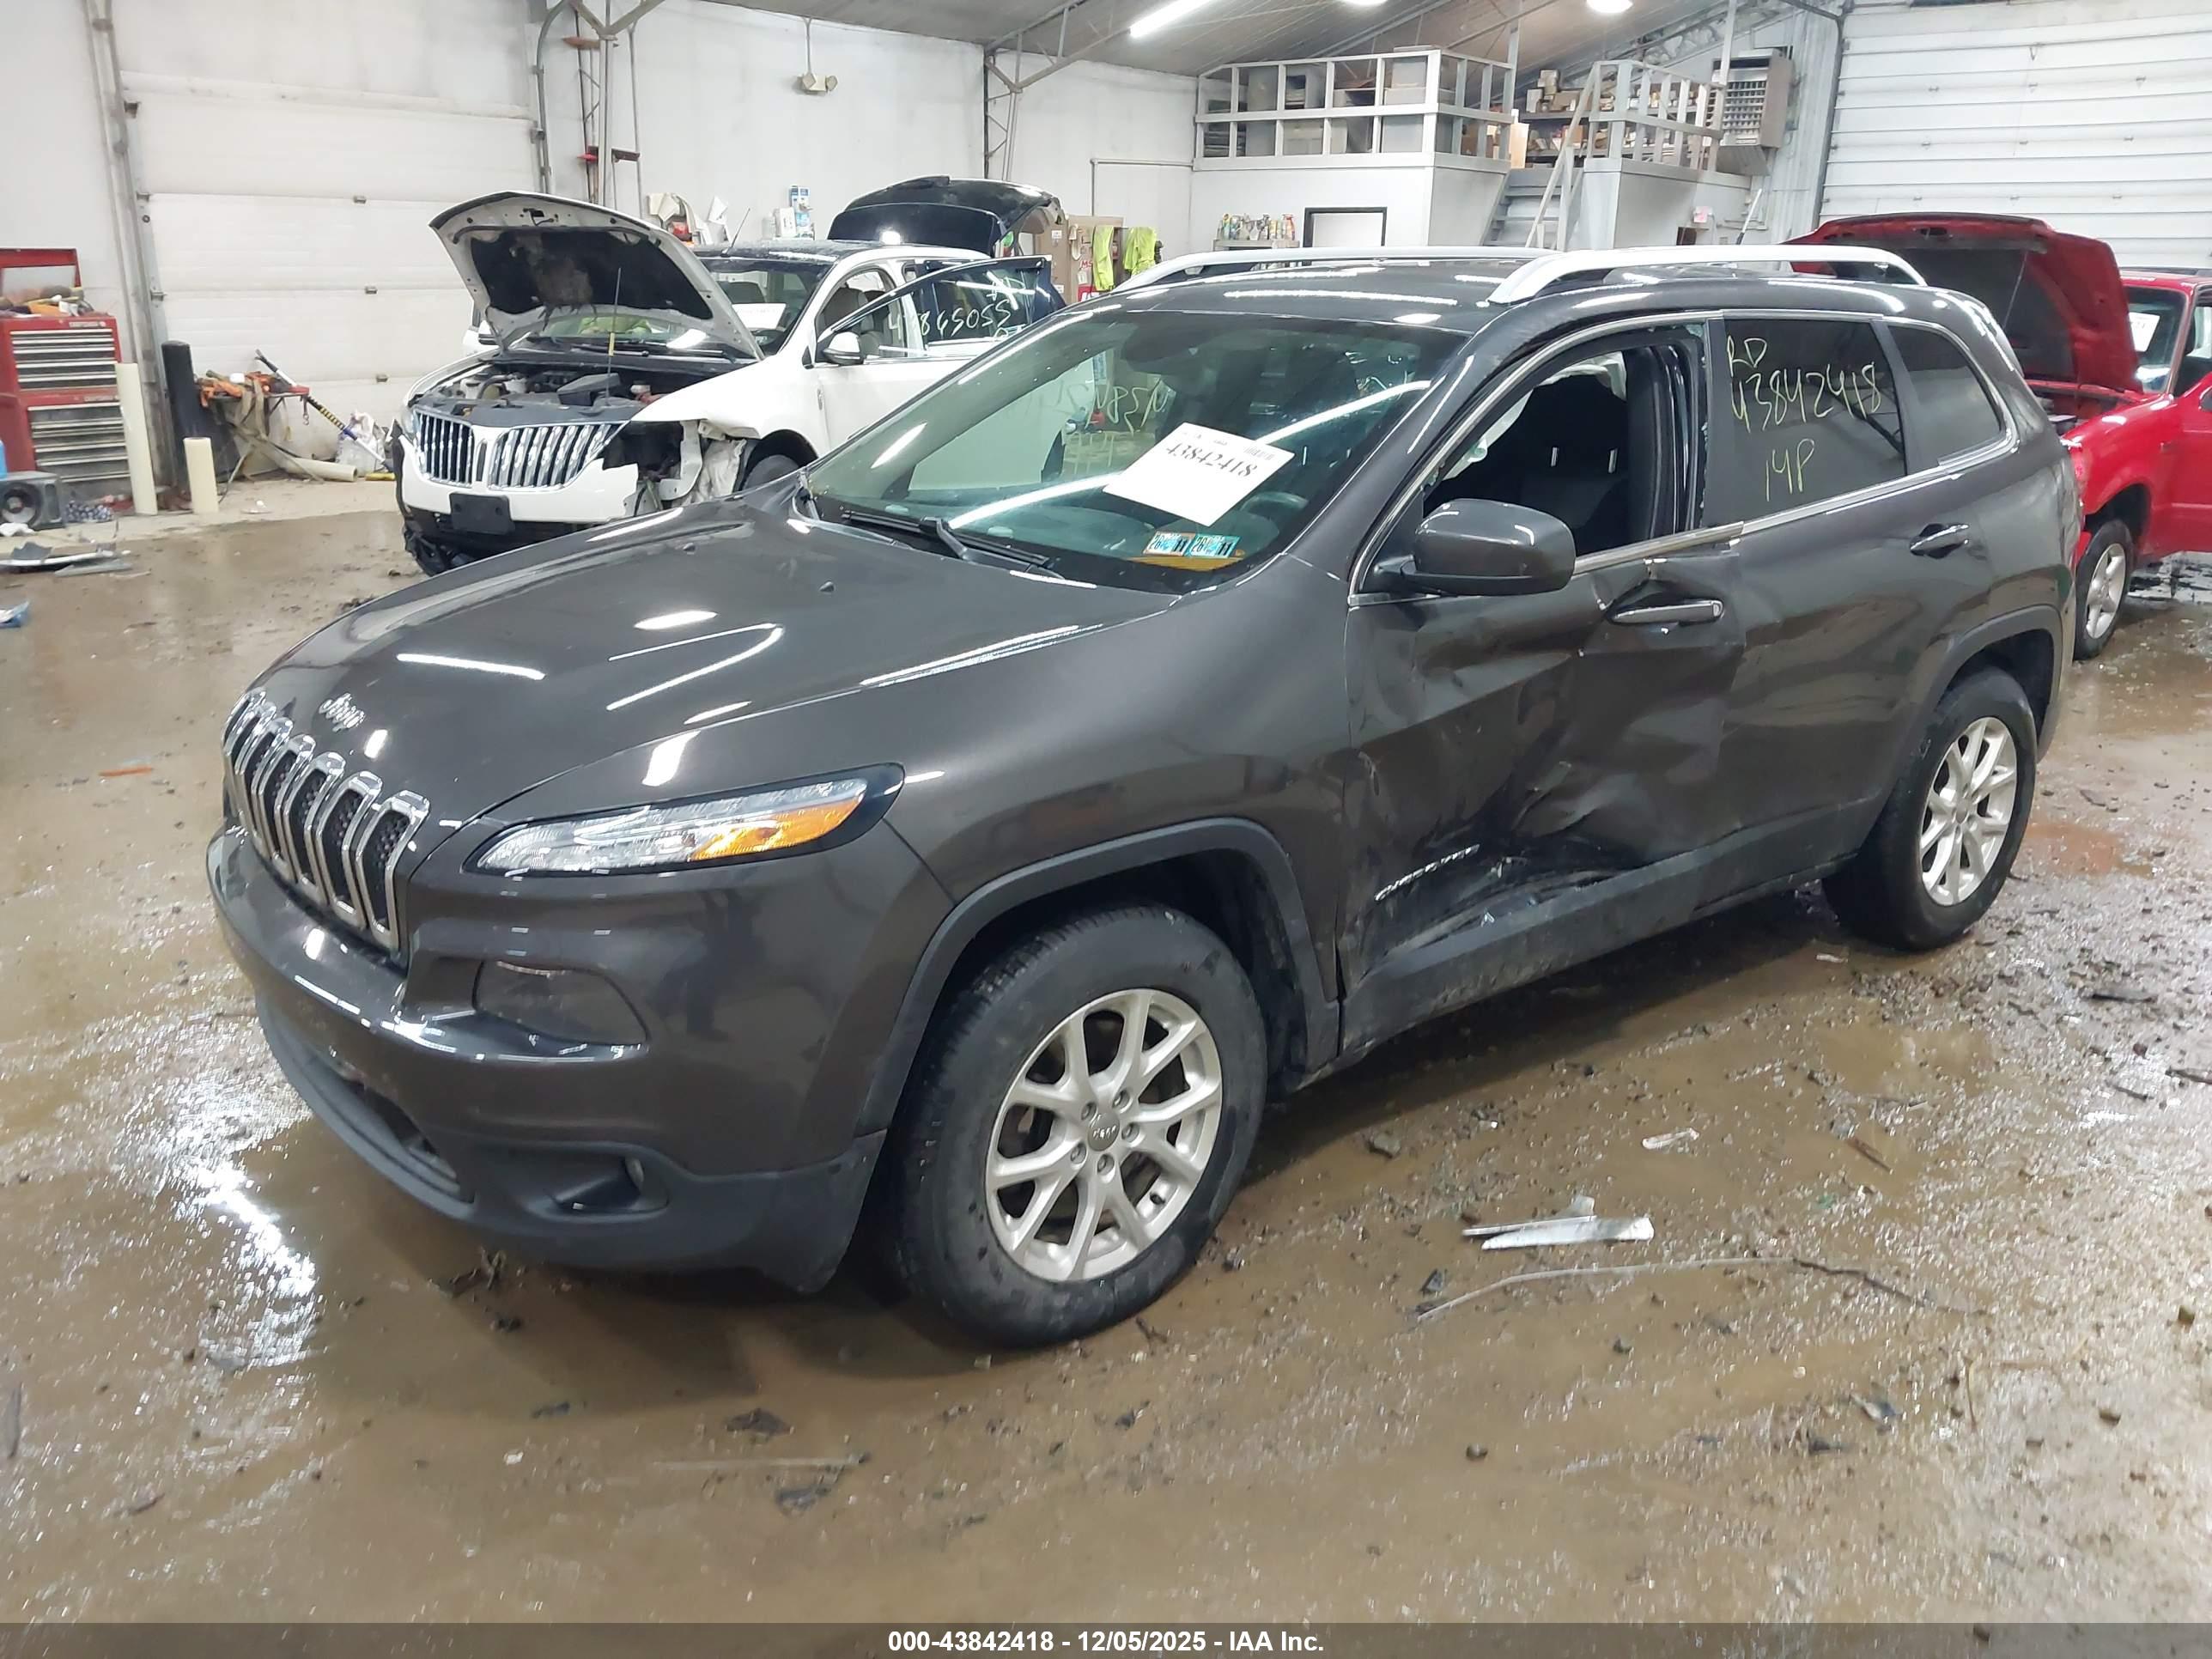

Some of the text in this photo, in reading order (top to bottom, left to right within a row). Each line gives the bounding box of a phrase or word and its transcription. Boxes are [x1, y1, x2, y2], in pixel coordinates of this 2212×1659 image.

[1727, 334, 1767, 377] RD
[1730, 362, 1881, 433] 43842418
[1165, 442, 1258, 477] 43842418
[1765, 438, 1814, 501] 14P
